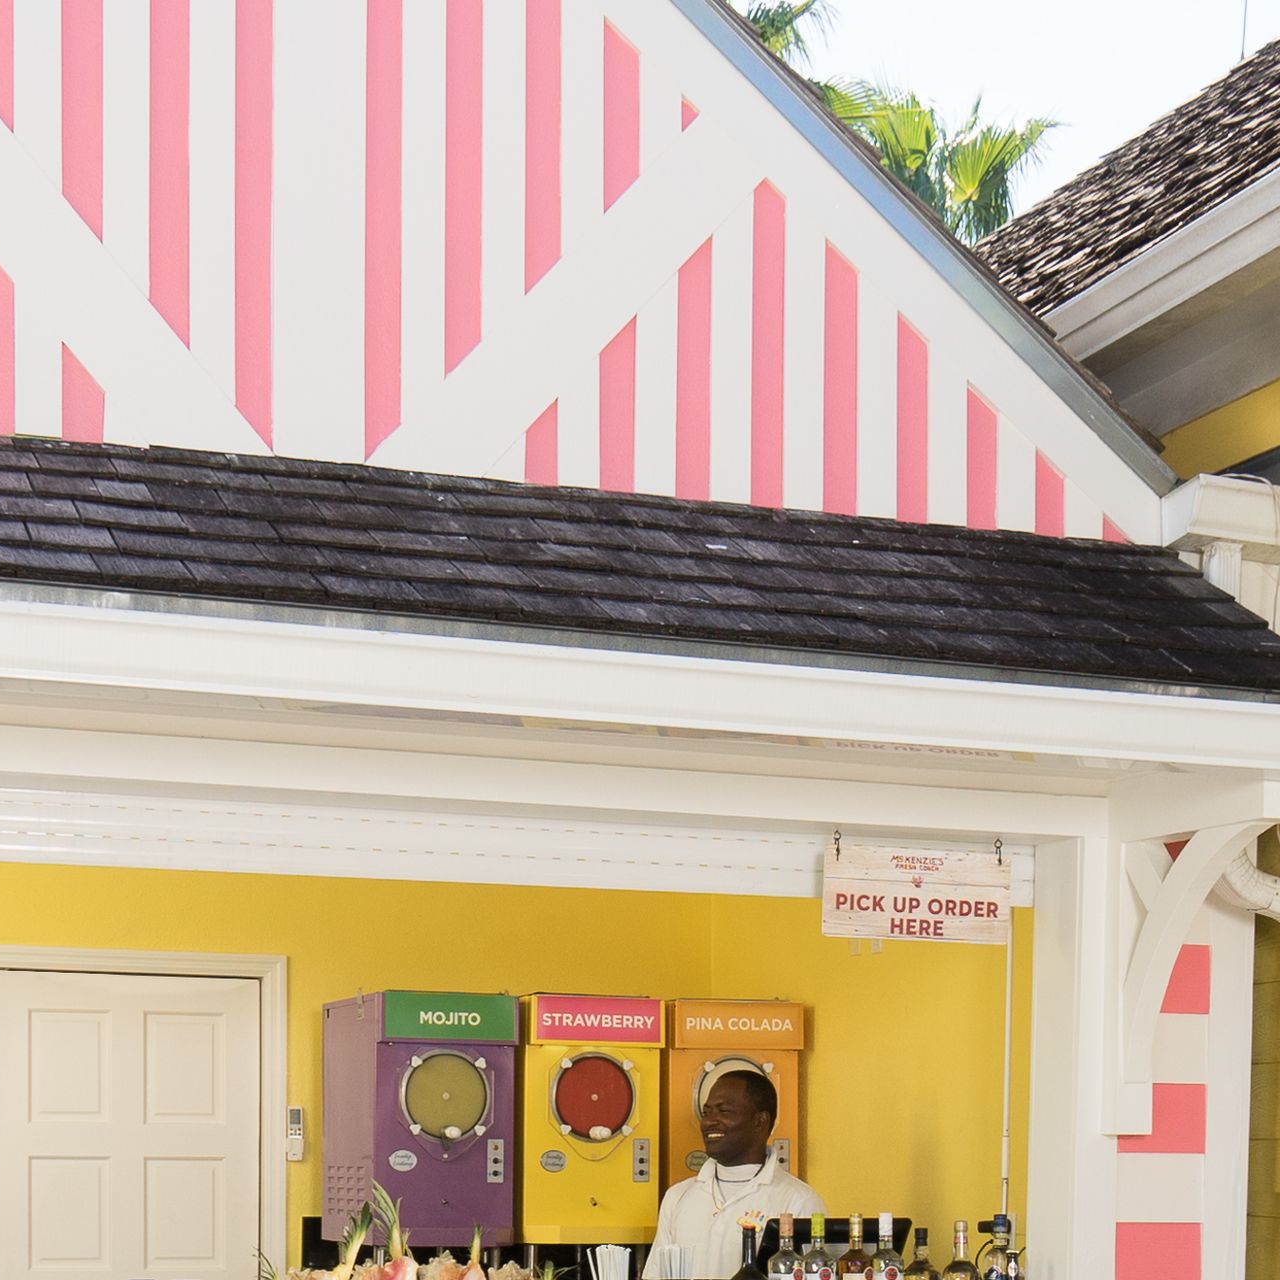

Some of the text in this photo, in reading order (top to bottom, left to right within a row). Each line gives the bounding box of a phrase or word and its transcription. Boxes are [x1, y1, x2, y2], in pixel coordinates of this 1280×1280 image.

[835, 893, 999, 918] PICK UP ORDER
[890, 917, 944, 936] HERE
[419, 1011, 482, 1026] MOJITO
[542, 1012, 655, 1029] STRAWBERRY
[685, 1016, 794, 1033] PINA COLADA
